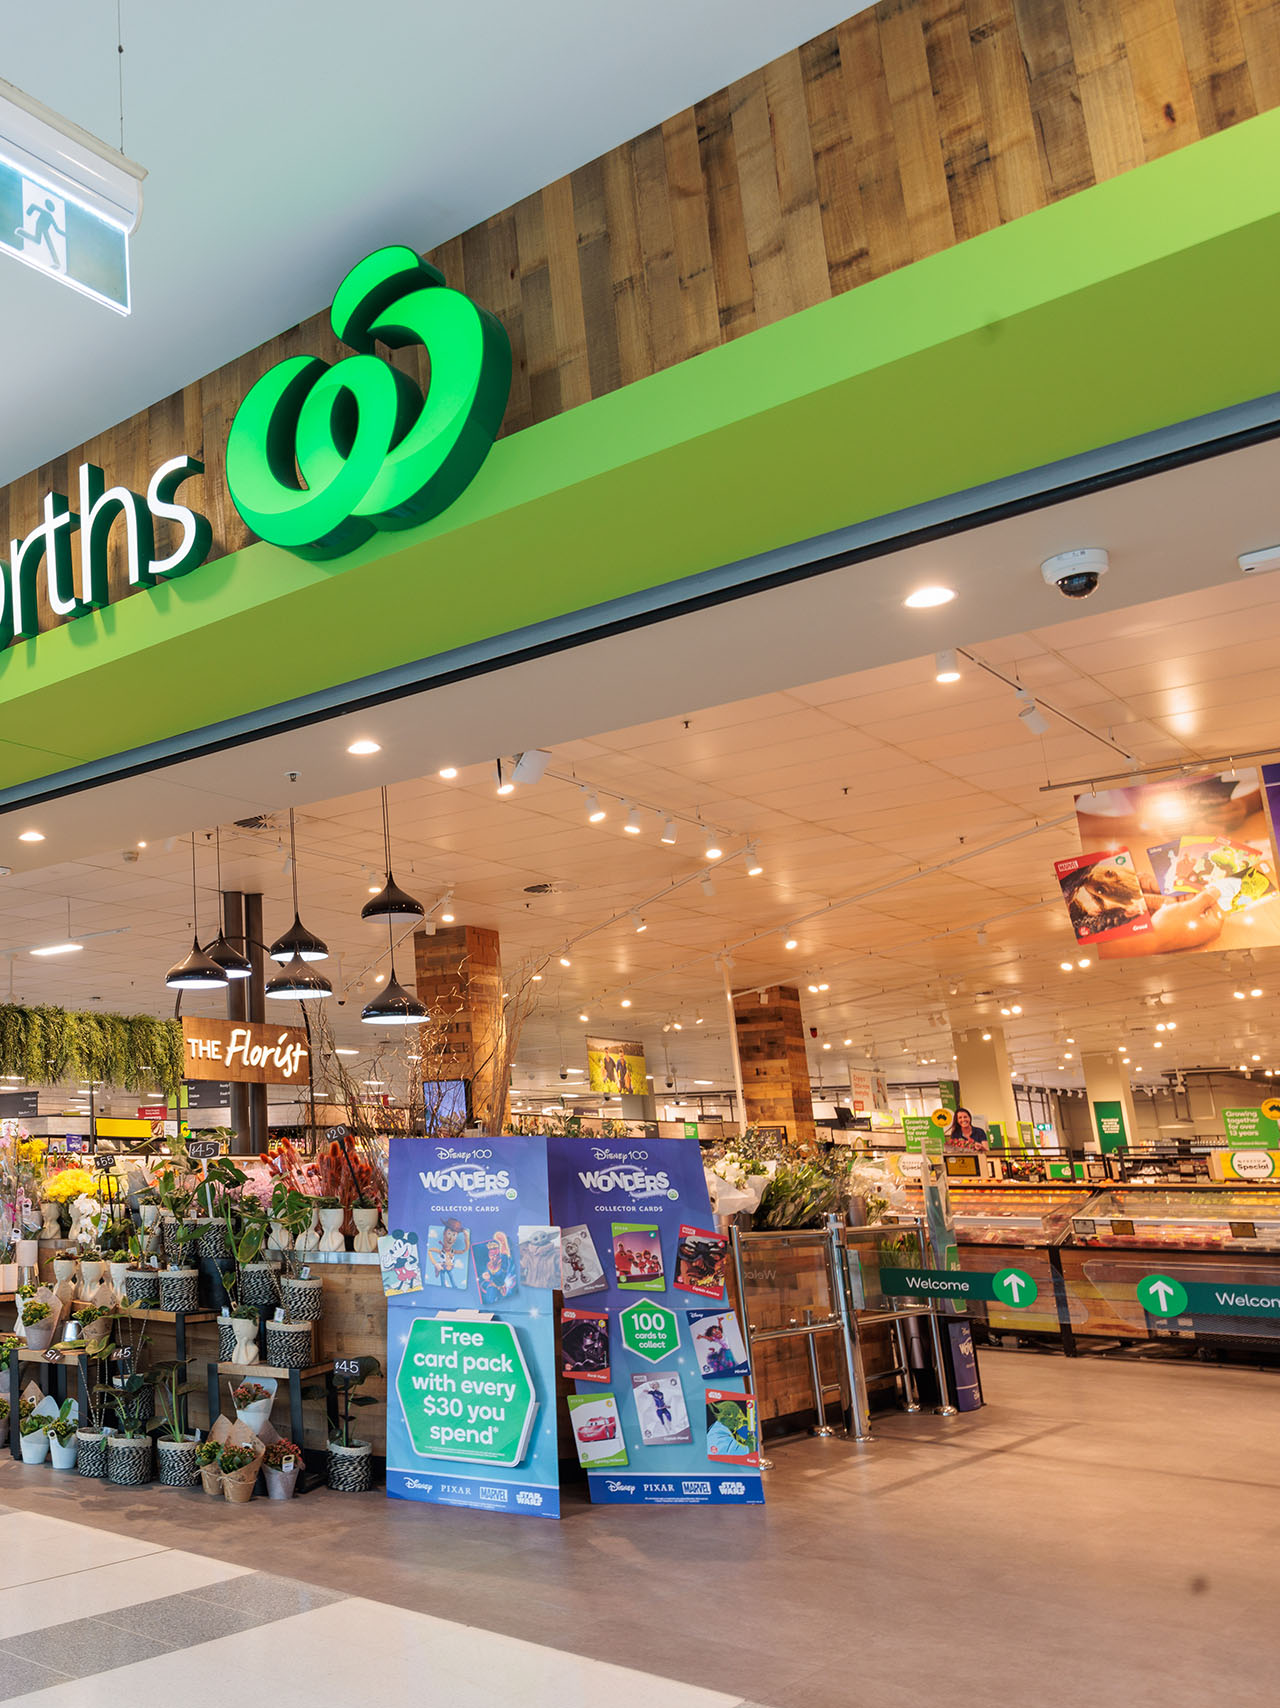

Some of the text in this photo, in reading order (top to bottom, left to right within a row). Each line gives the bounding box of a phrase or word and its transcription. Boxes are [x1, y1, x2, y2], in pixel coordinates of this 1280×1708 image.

[186, 1028, 308, 1078] THE Florist
[326, 1125, 346, 1140] $20
[1238, 1130, 1259, 1138] years
[191, 1142, 215, 1156] $45
[434, 1147, 493, 1163] Disney 100
[590, 1147, 649, 1163] Disney 100
[96, 1155, 114, 1167] $55
[418, 1170, 510, 1192] WONDERS
[578, 1171, 670, 1192] WONDERS
[905, 1275, 970, 1293] Welcome
[631, 1313, 666, 1331] 100
[440, 1326, 484, 1347] Free
[634, 1332, 667, 1340] cards to
[638, 1341, 666, 1349] collect
[335, 1360, 359, 1374] $45
[413, 1350, 514, 1375] card pack
[411, 1372, 516, 1403] with every
[423, 1394, 505, 1424] $30 you
[403, 1476, 508, 1503] Disney PIXAR MARVEL
[605, 1480, 711, 1495] Disney PIXAR MARVEL
[718, 1487, 746, 1495] WARS
[720, 1481, 744, 1489] STAR
[516, 1497, 543, 1507] WARS
[518, 1491, 541, 1499] STAR
